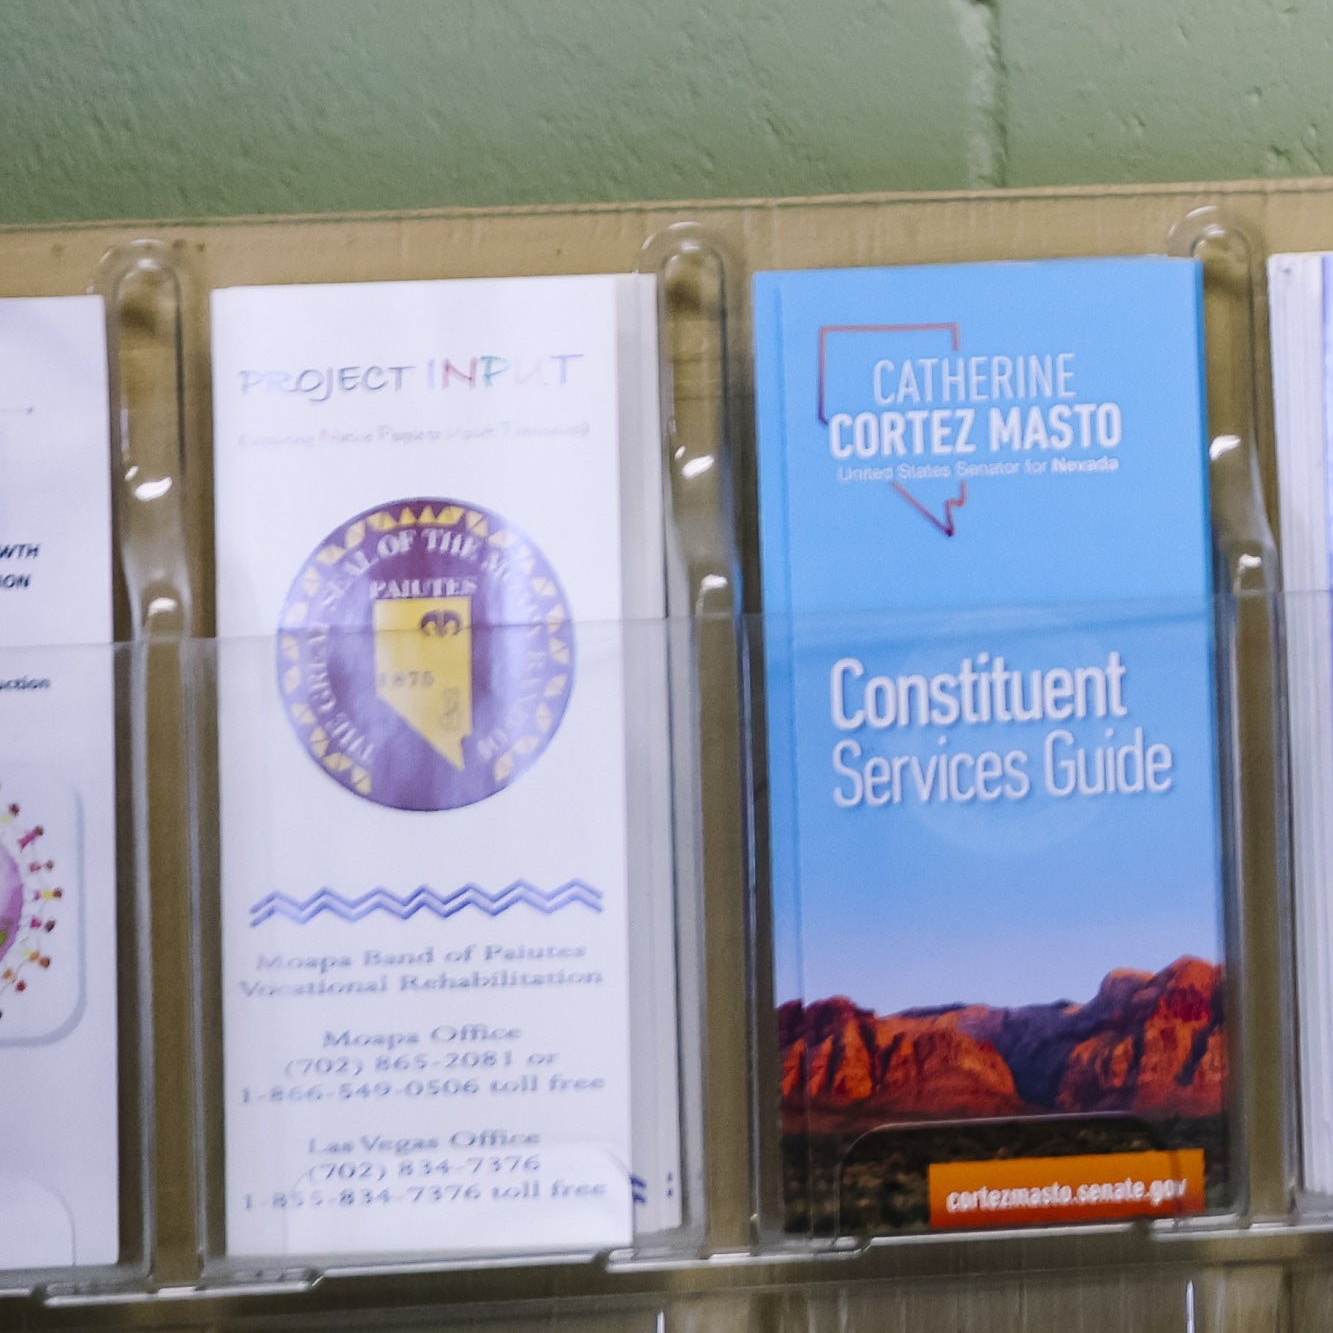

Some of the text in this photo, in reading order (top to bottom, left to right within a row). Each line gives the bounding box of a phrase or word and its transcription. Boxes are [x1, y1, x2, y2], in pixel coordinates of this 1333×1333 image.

[237, 353, 584, 403] PROJECT INPUT
[873, 352, 1077, 406] CATHERINE
[829, 401, 1122, 458] CORTEZ MASTO
[837, 456, 1120, 482] United States Senator for Nevada
[369, 577, 479, 600] PAIUTES
[829, 650, 1128, 730] Constituent
[832, 726, 1173, 808] Services Guide
[256, 941, 587, 974] Moapa Band of Paiutes
[238, 970, 604, 998] Vocational Rehabilitation
[322, 1023, 523, 1050] Moapa Office
[284, 1050, 560, 1078] (702) 865-2081 or
[488, 1073, 539, 1093] toll
[548, 1072, 606, 1092] free
[308, 1128, 542, 1156] Las Vegas Office
[307, 1154, 541, 1183] (702) 834-7376
[491, 1180, 540, 1201] toll
[550, 1178, 608, 1199] free
[945, 1176, 1188, 1213] cortezmasto.senate.gov
